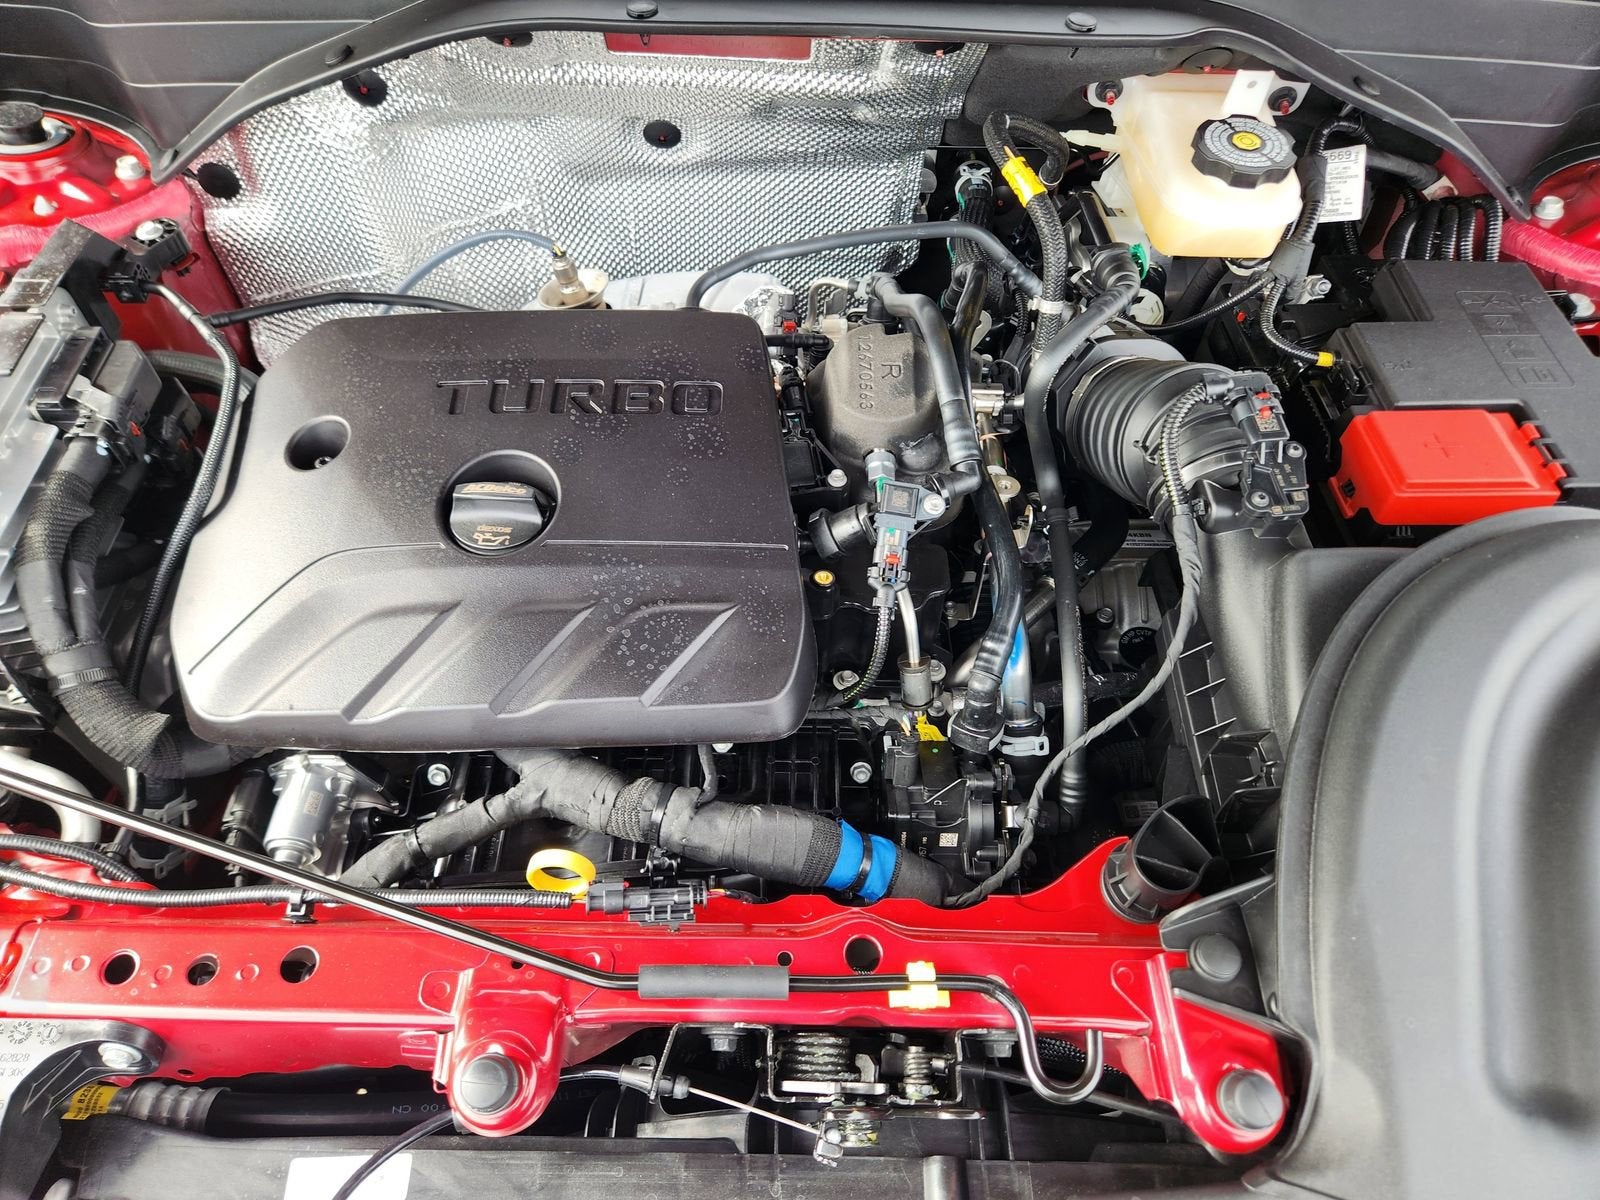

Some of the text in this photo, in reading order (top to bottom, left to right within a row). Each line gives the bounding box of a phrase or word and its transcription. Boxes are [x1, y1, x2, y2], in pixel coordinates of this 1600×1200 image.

[881, 363, 903, 379] R
[437, 378, 724, 416] TURBO
[461, 484, 527, 496] ACDelco
